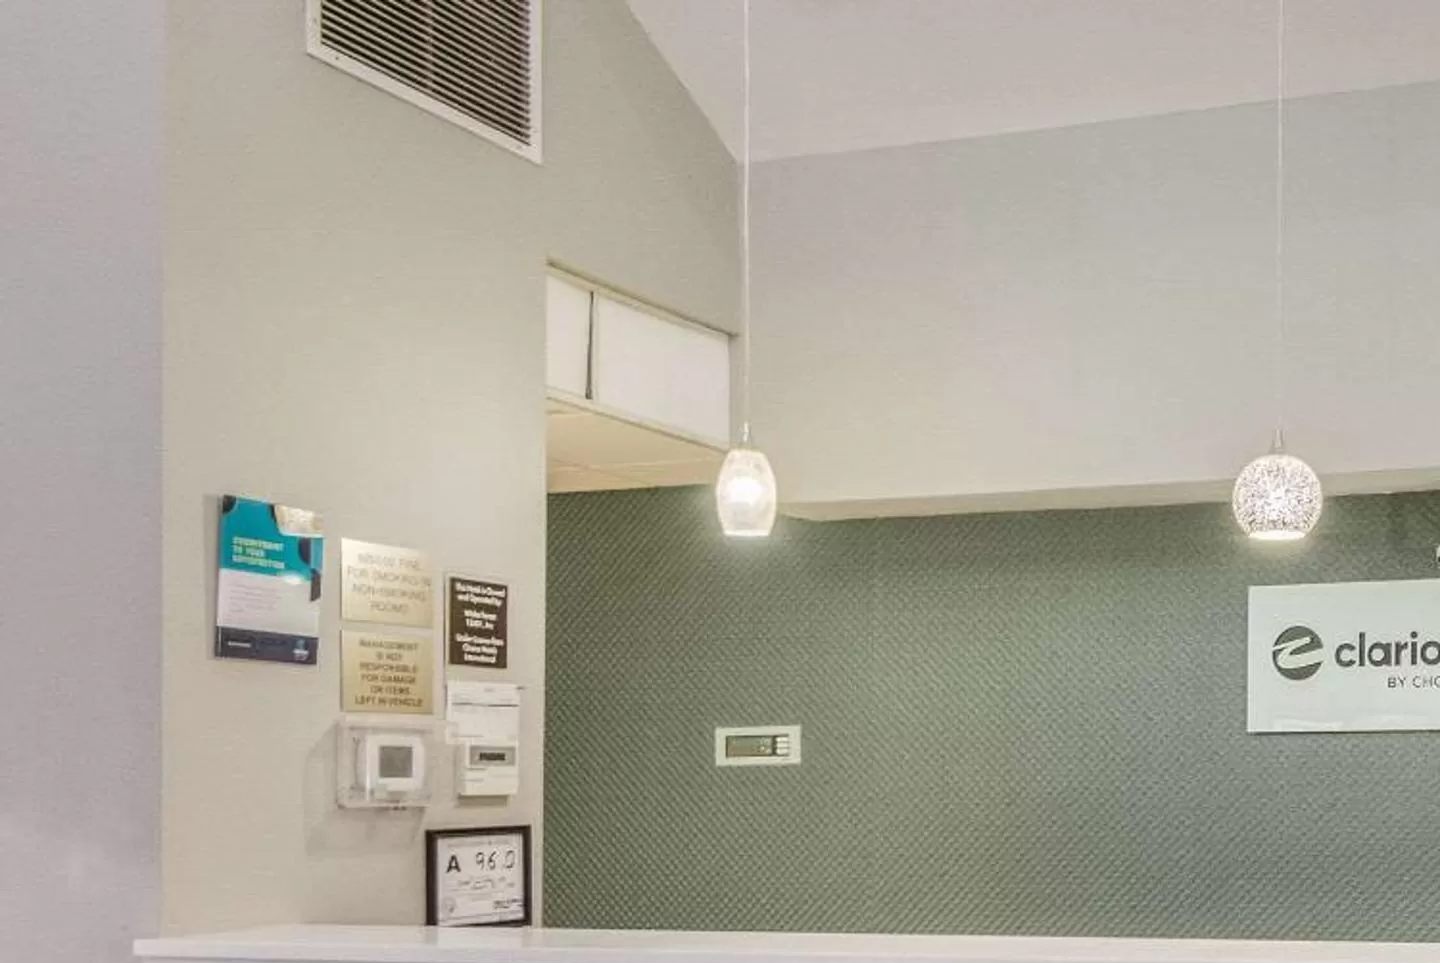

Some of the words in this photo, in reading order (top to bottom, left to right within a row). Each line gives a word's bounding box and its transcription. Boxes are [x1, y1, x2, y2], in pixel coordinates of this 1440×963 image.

[1387, 676, 1406, 688] BY
[354, 695, 376, 705] LEFT
[446, 855, 461, 873] A
